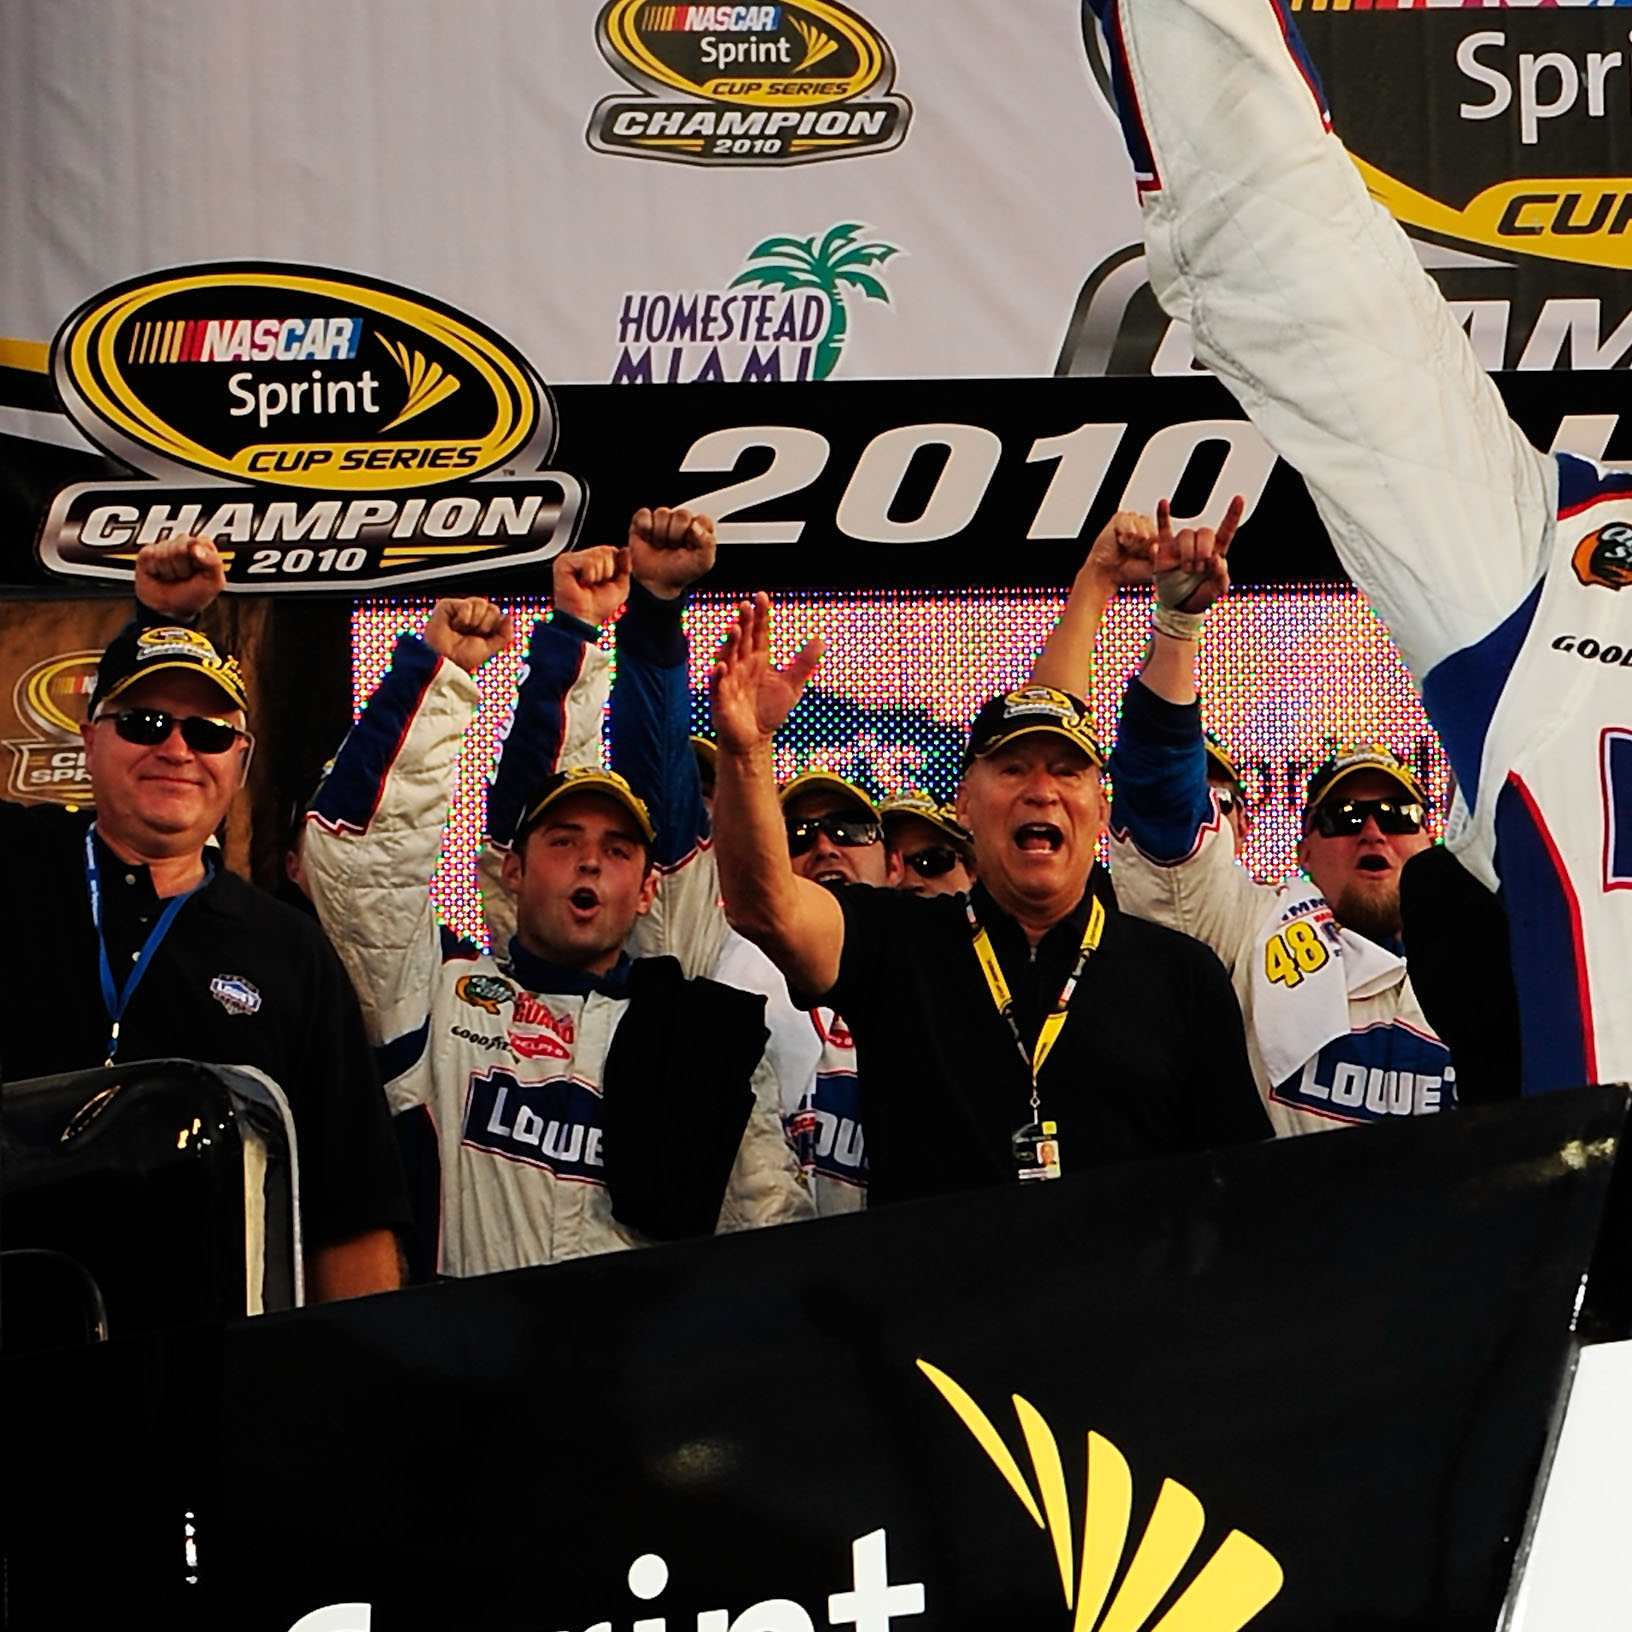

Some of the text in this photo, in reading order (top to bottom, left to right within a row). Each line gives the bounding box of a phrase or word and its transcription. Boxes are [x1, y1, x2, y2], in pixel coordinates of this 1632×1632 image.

[683, 6, 778, 32] NASCAR
[699, 35, 792, 70] Sprint
[710, 81, 850, 96] CUP SERIES
[611, 110, 888, 136] CHAMPION
[711, 139, 782, 155] 2010
[618, 294, 826, 343] HOMESTEAD
[199, 319, 355, 363] NASCAR
[610, 345, 812, 385] MIAMI
[227, 371, 381, 429] Sprint
[246, 445, 484, 473] CUP SERIES
[675, 420, 1280, 544] 2010
[79, 495, 544, 547] CHAMPION
[247, 549, 369, 574] 2010
[1265, 921, 1330, 989] 48
[487, 1086, 604, 1165] LOWE
